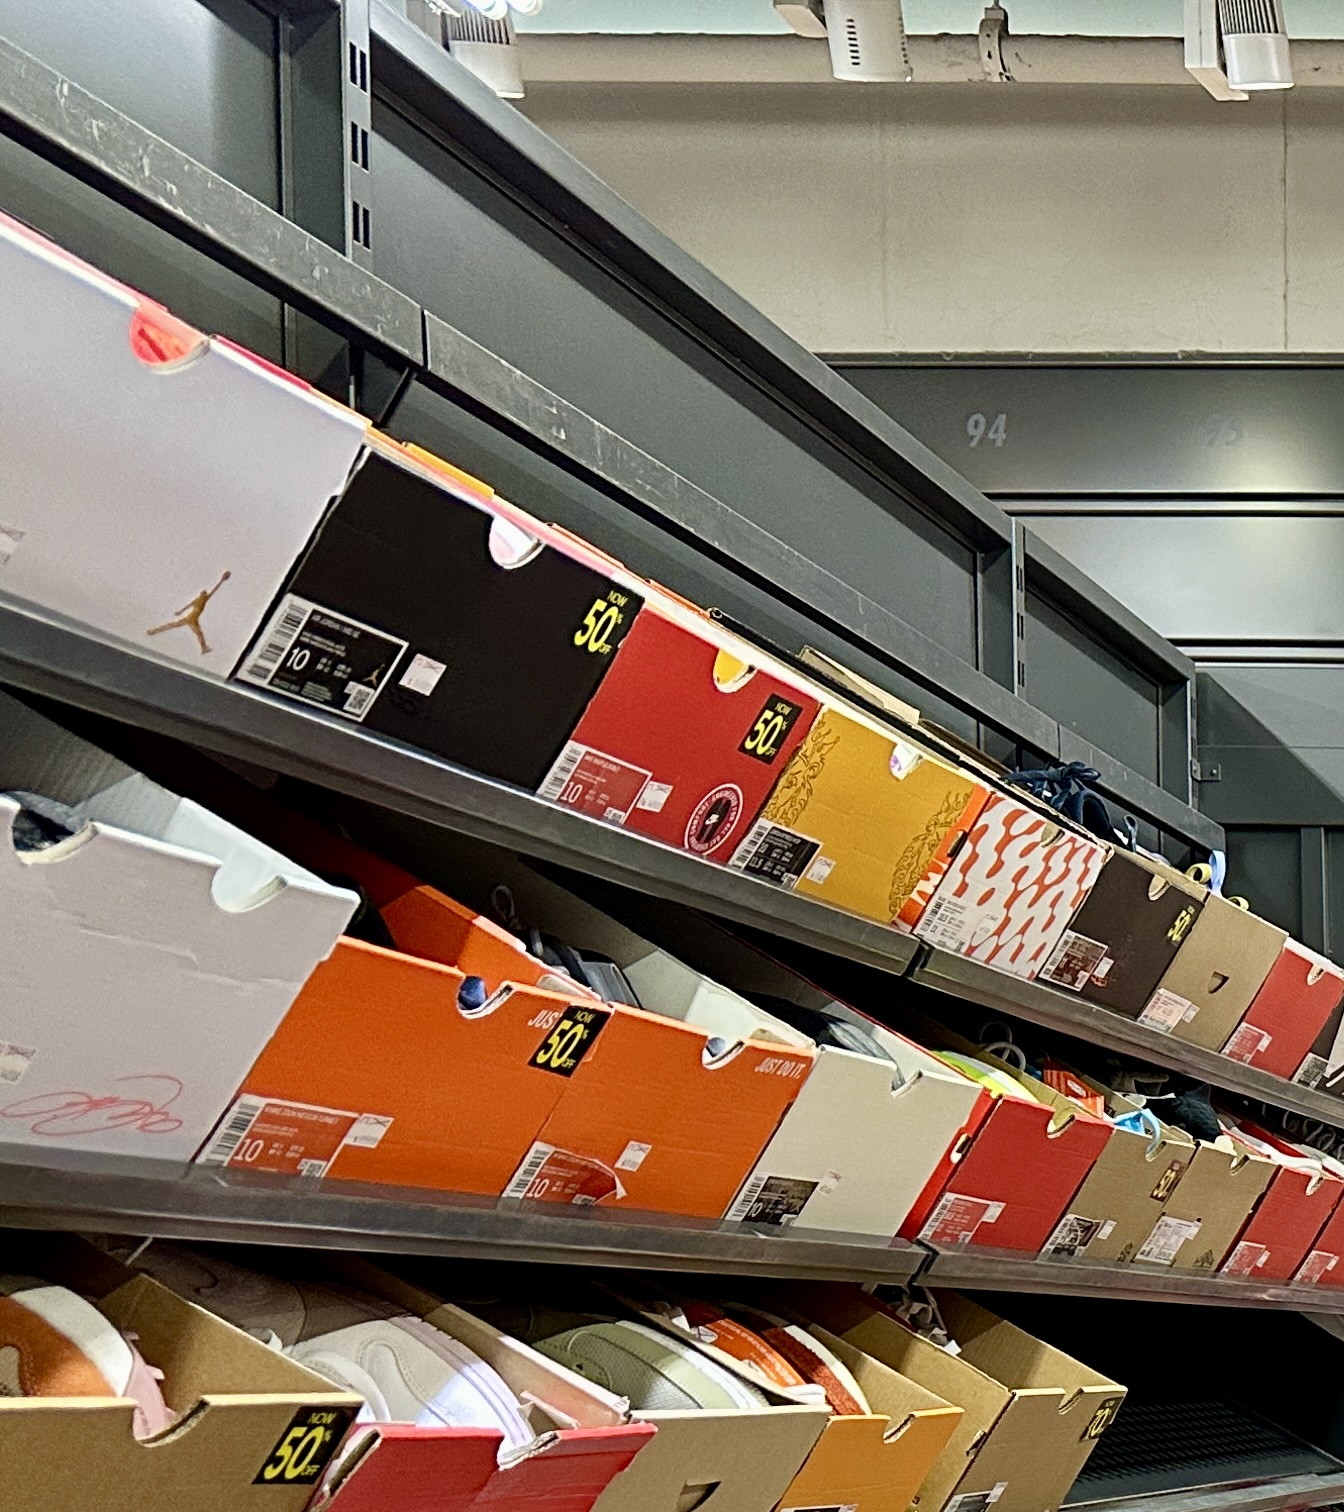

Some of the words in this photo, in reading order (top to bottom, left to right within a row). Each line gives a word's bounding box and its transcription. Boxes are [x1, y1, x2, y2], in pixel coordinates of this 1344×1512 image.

[965, 412, 1008, 448] 94
[286, 647, 311, 671] 10
[560, 780, 584, 803] 10
[527, 1008, 558, 1031] JUS
[575, 1009, 596, 1023] NOW
[754, 1057, 777, 1075] JUST
[233, 1138, 265, 1163] 10
[527, 1177, 550, 1198] 10
[308, 1412, 337, 1424] NOW
[301, 1465, 321, 1476] OFF
